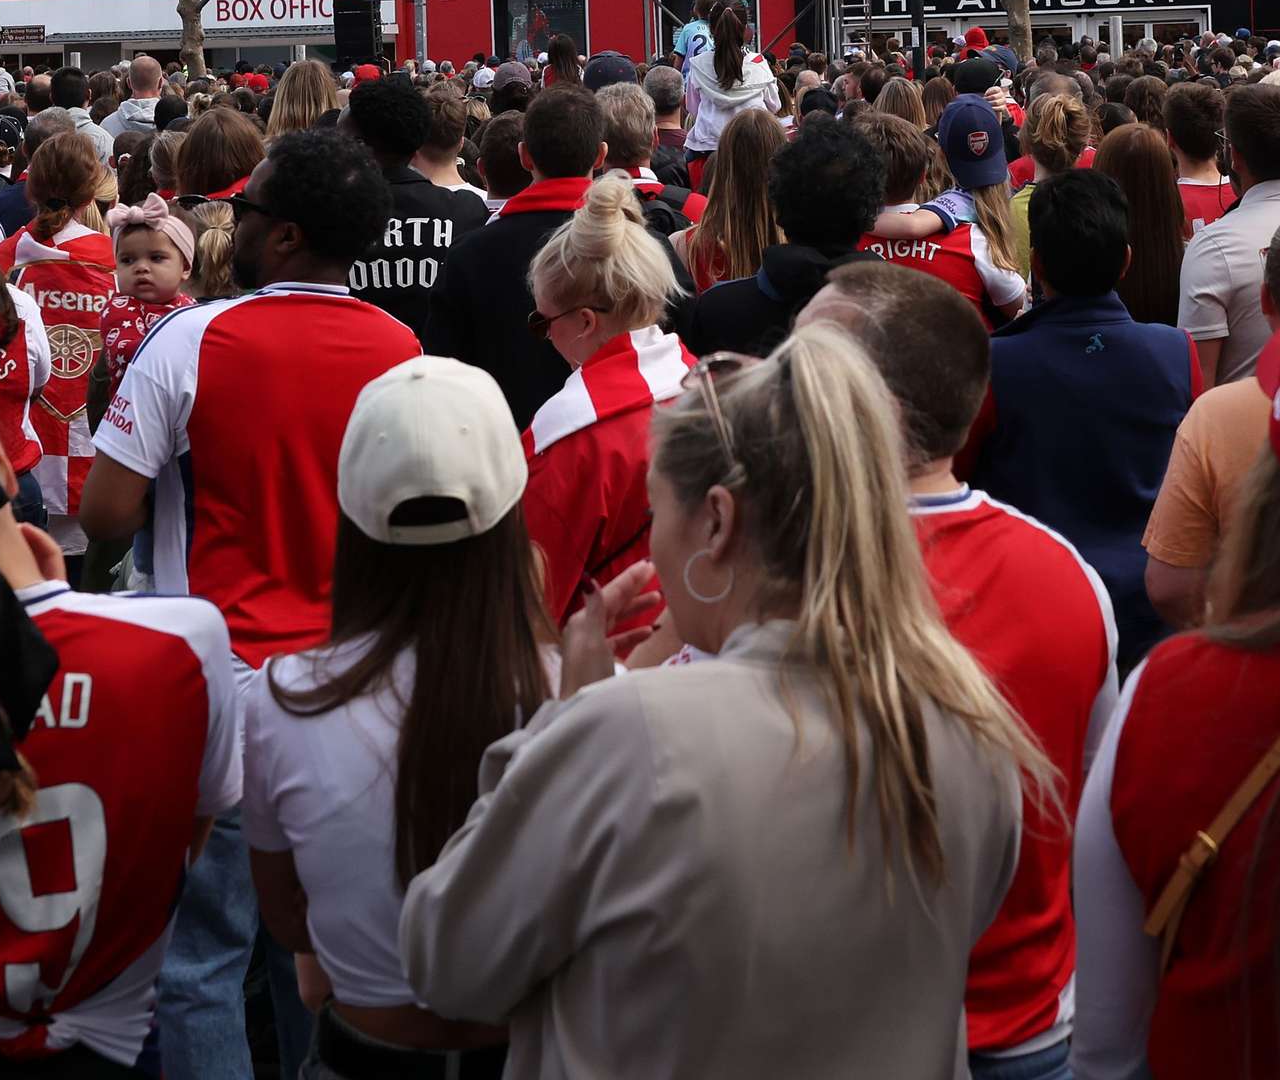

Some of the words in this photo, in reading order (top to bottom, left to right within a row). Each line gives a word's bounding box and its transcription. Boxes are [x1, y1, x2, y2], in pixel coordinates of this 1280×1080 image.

[383, 217, 454, 248] RTH
[869, 239, 942, 261] RIGHT
[111, 393, 131, 414] ISIT
[104, 407, 134, 436] ANDA
[31, 672, 93, 729] AD
